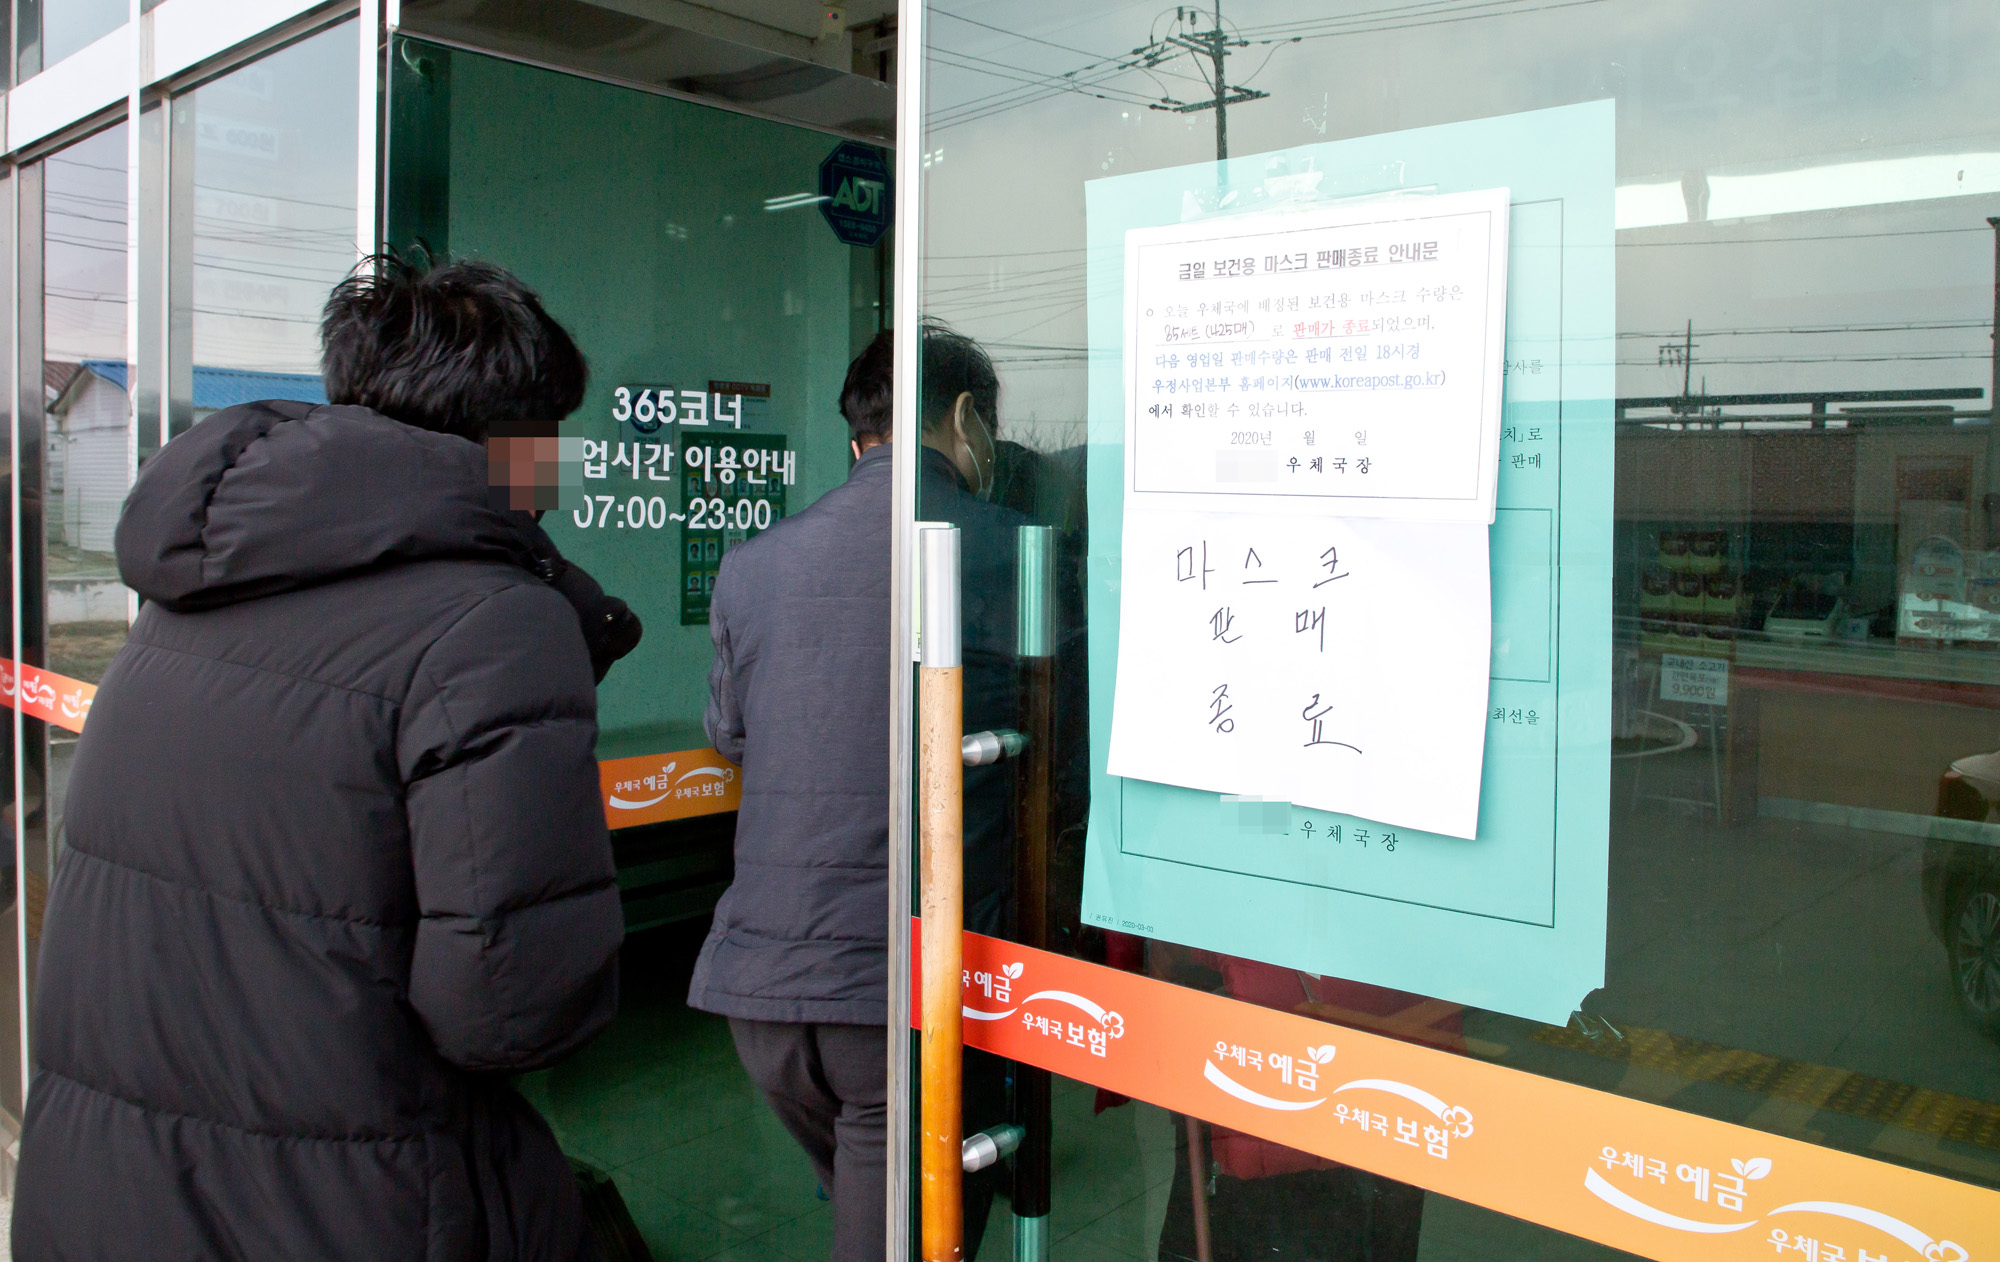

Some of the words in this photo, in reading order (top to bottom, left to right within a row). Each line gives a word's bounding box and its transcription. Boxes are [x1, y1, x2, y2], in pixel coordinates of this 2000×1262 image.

[832, 176, 885, 215] ADT
[1178, 261, 1206, 280] 금일
[1213, 258, 1256, 277] 보건용
[1264, 254, 1308, 272] 마스크
[1316, 247, 1379, 268] 판매종료
[1388, 240, 1439, 262] 안내문
[1163, 305, 1189, 319] 오늘
[1196, 300, 1250, 317] 우체국에
[1258, 295, 1300, 312] 배정된
[1308, 293, 1351, 310] 보건용
[1360, 289, 1406, 307] 마스크
[1415, 285, 1464, 303] 수량은
[1272, 324, 1285, 337] 로
[1292, 321, 1336, 337] 판매가
[1342, 315, 1435, 335] 종료되었으며,
[1155, 355, 1180, 368] 다음
[1186, 352, 1225, 367] 영업일
[1231, 349, 1299, 366] 판매수량은
[1305, 347, 1332, 364] 판매
[1339, 345, 1370, 362] 전일
[1375, 344, 1420, 361] 18시경
[1151, 377, 1231, 393] 우정사업본부
[612, 386, 742, 429] 365코너
[1148, 403, 1173, 418] 에서
[1181, 402, 1220, 418] 확인할
[1227, 402, 1240, 416] 수
[1248, 402, 1308, 417] 있습니다.
[1230, 430, 1273, 446] 2020년
[1303, 430, 1315, 445] 월
[1355, 429, 1368, 445] 일
[1500, 426, 1543, 443] 치」로
[581, 437, 675, 482] 업시간
[685, 445, 797, 485] 이용안내
[1511, 453, 1541, 469] 판매
[573, 494, 771, 531] 07:00~23:00
[1176, 539, 1350, 591] 마스크
[1492, 706, 1540, 726] 최선을
[614, 780, 641, 792] 우체국
[643, 775, 669, 791] 예금
[675, 787, 700, 799] 우체국
[702, 781, 725, 797] 보험
[974, 970, 1013, 1003] 예금
[1021, 1012, 1064, 1040] 우체국
[1065, 1022, 1107, 1058] 보험
[1213, 1041, 1264, 1071] 우체국
[1268, 1054, 1320, 1092] 예금
[1333, 1103, 1390, 1136] 우체국
[1395, 1116, 1449, 1160] 보험
[1598, 1146, 1669, 1184] 우체국
[1675, 1162, 1748, 1213] 예금
